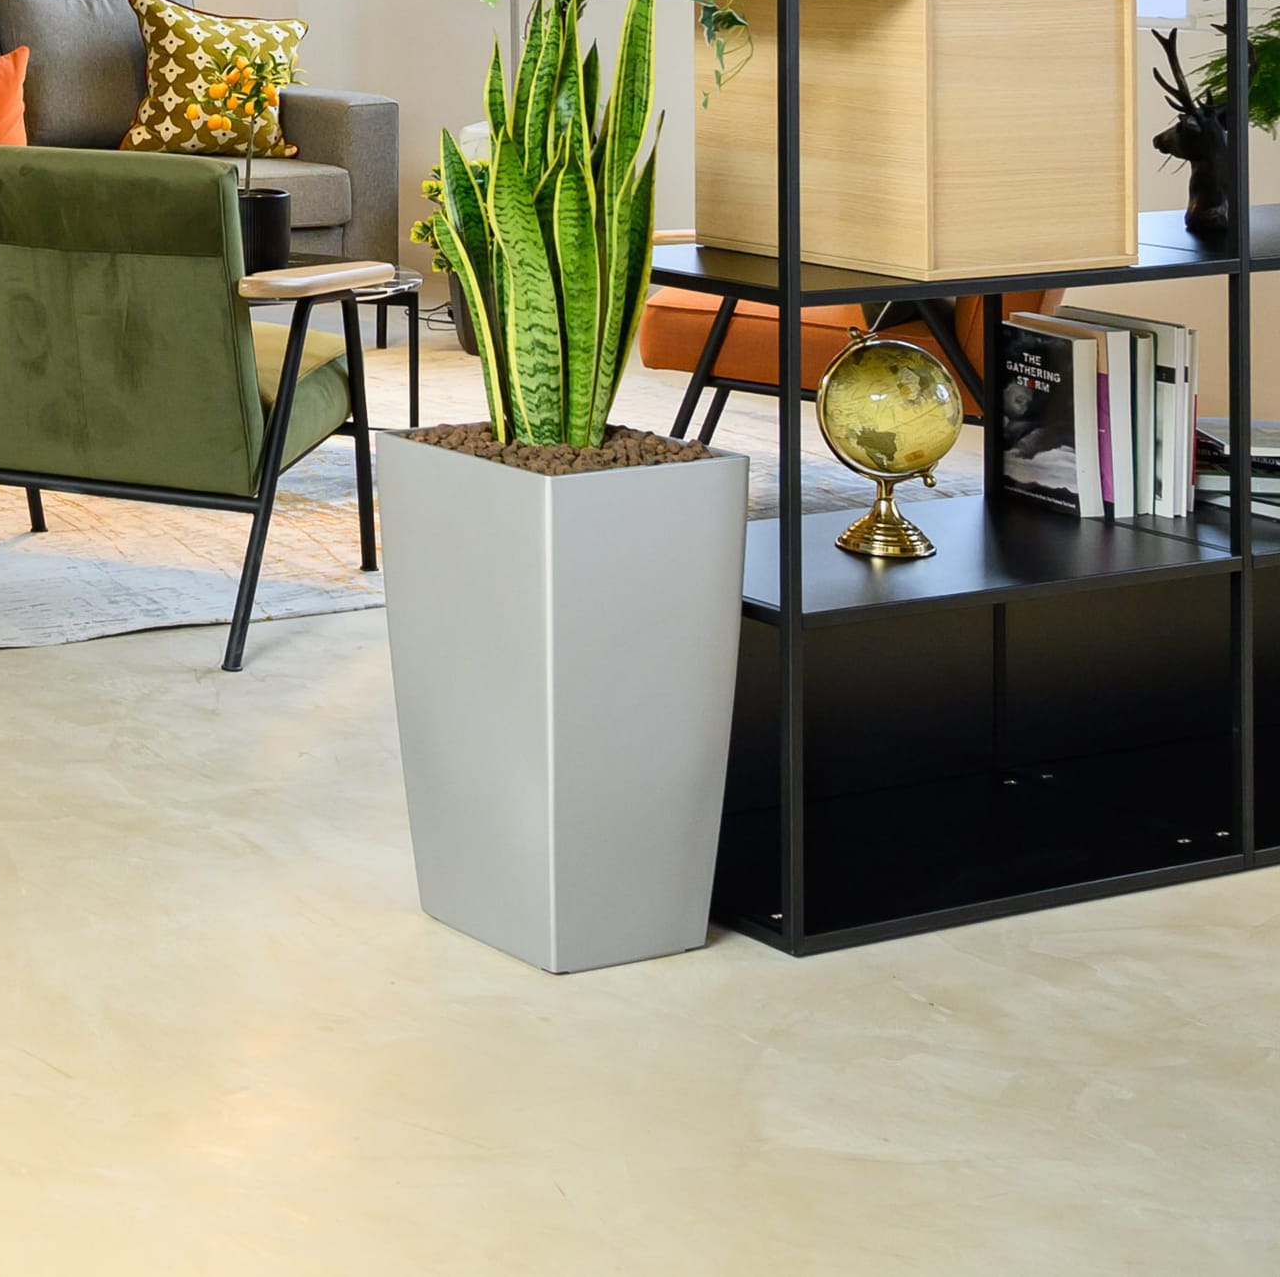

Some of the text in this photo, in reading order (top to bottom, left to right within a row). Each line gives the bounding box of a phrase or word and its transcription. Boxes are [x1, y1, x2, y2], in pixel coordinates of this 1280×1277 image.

[1022, 352, 1042, 366] THE
[1006, 360, 1061, 383] GATHERING
[1016, 375, 1050, 393] STORM
